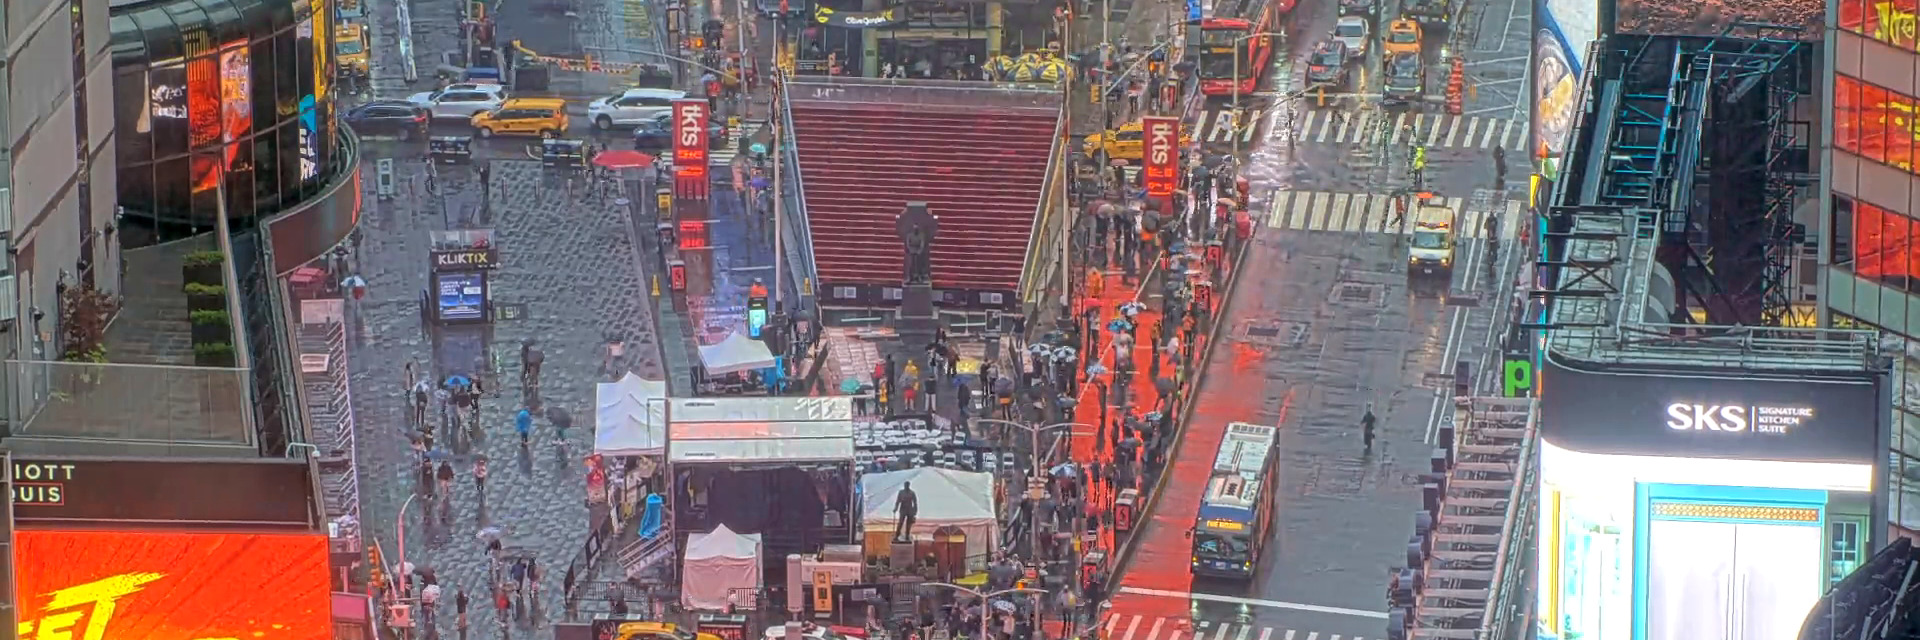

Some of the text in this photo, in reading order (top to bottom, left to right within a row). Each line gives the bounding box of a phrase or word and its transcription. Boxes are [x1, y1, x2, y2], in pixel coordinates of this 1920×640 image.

[681, 104, 702, 147] tkts
[1152, 122, 1173, 165] tkts
[438, 253, 488, 265] KLIKTIX
[1667, 402, 1747, 432] SKS
[1758, 407, 1813, 416] SIGNATURE
[1758, 416, 1800, 425] KITCHEN
[1758, 425, 1787, 433] SUITE
